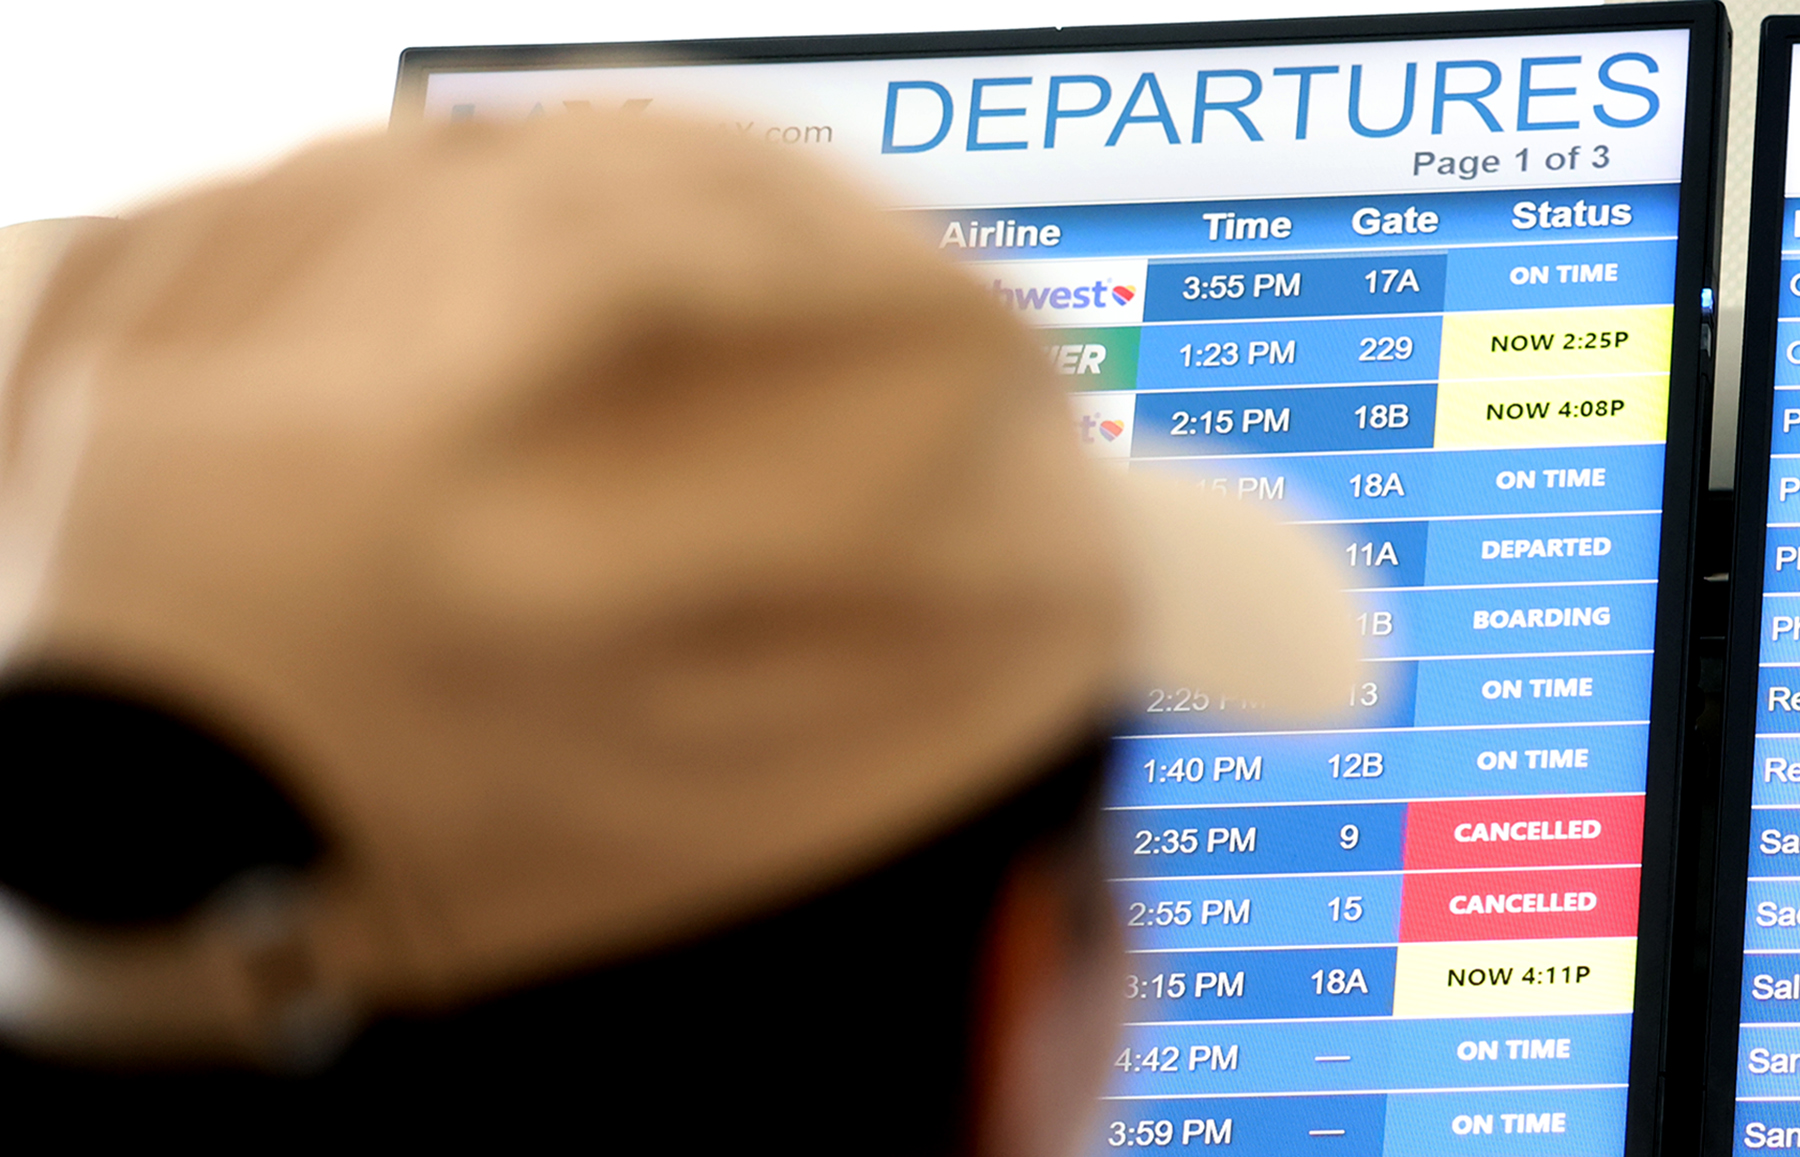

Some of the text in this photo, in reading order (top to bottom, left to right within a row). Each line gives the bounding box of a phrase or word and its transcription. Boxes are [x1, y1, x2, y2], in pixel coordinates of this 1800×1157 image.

[880, 51, 1660, 154] DEPARTURES
[1413, 144, 1611, 179] Page 1 of 3
[939, 219, 1062, 249] Airline
[1203, 200, 1632, 241] Time Gate Status
[992, 280, 1108, 310] hwest
[1183, 263, 1618, 300] 3:55 PM 17A ON TIME
[1179, 331, 1629, 367] 1:23 PM 229 NOW 2:25P
[1170, 400, 1625, 435] 2:15 PM 18B NOW 4:08P
[1238, 476, 1286, 500] PM
[1348, 473, 1405, 498] 18A
[1345, 537, 1611, 567] 11A DEPARTED
[1473, 607, 1611, 629] BOARDING
[1481, 679, 1522, 699] ON
[1530, 677, 1592, 698] TIME
[1143, 753, 1384, 783] 1:40 PM 12B
[1134, 820, 1602, 855] 2:35 PM 9 CANCELLED
[1128, 892, 1597, 927] 2:55 PM 15 CANCELLED
[1124, 965, 1590, 999] 3:15 PM 18A NOW 4:11P
[1115, 1039, 1571, 1073] 4:42 PM ON TIME
[1109, 1120, 1233, 1147] 3:59 PM
